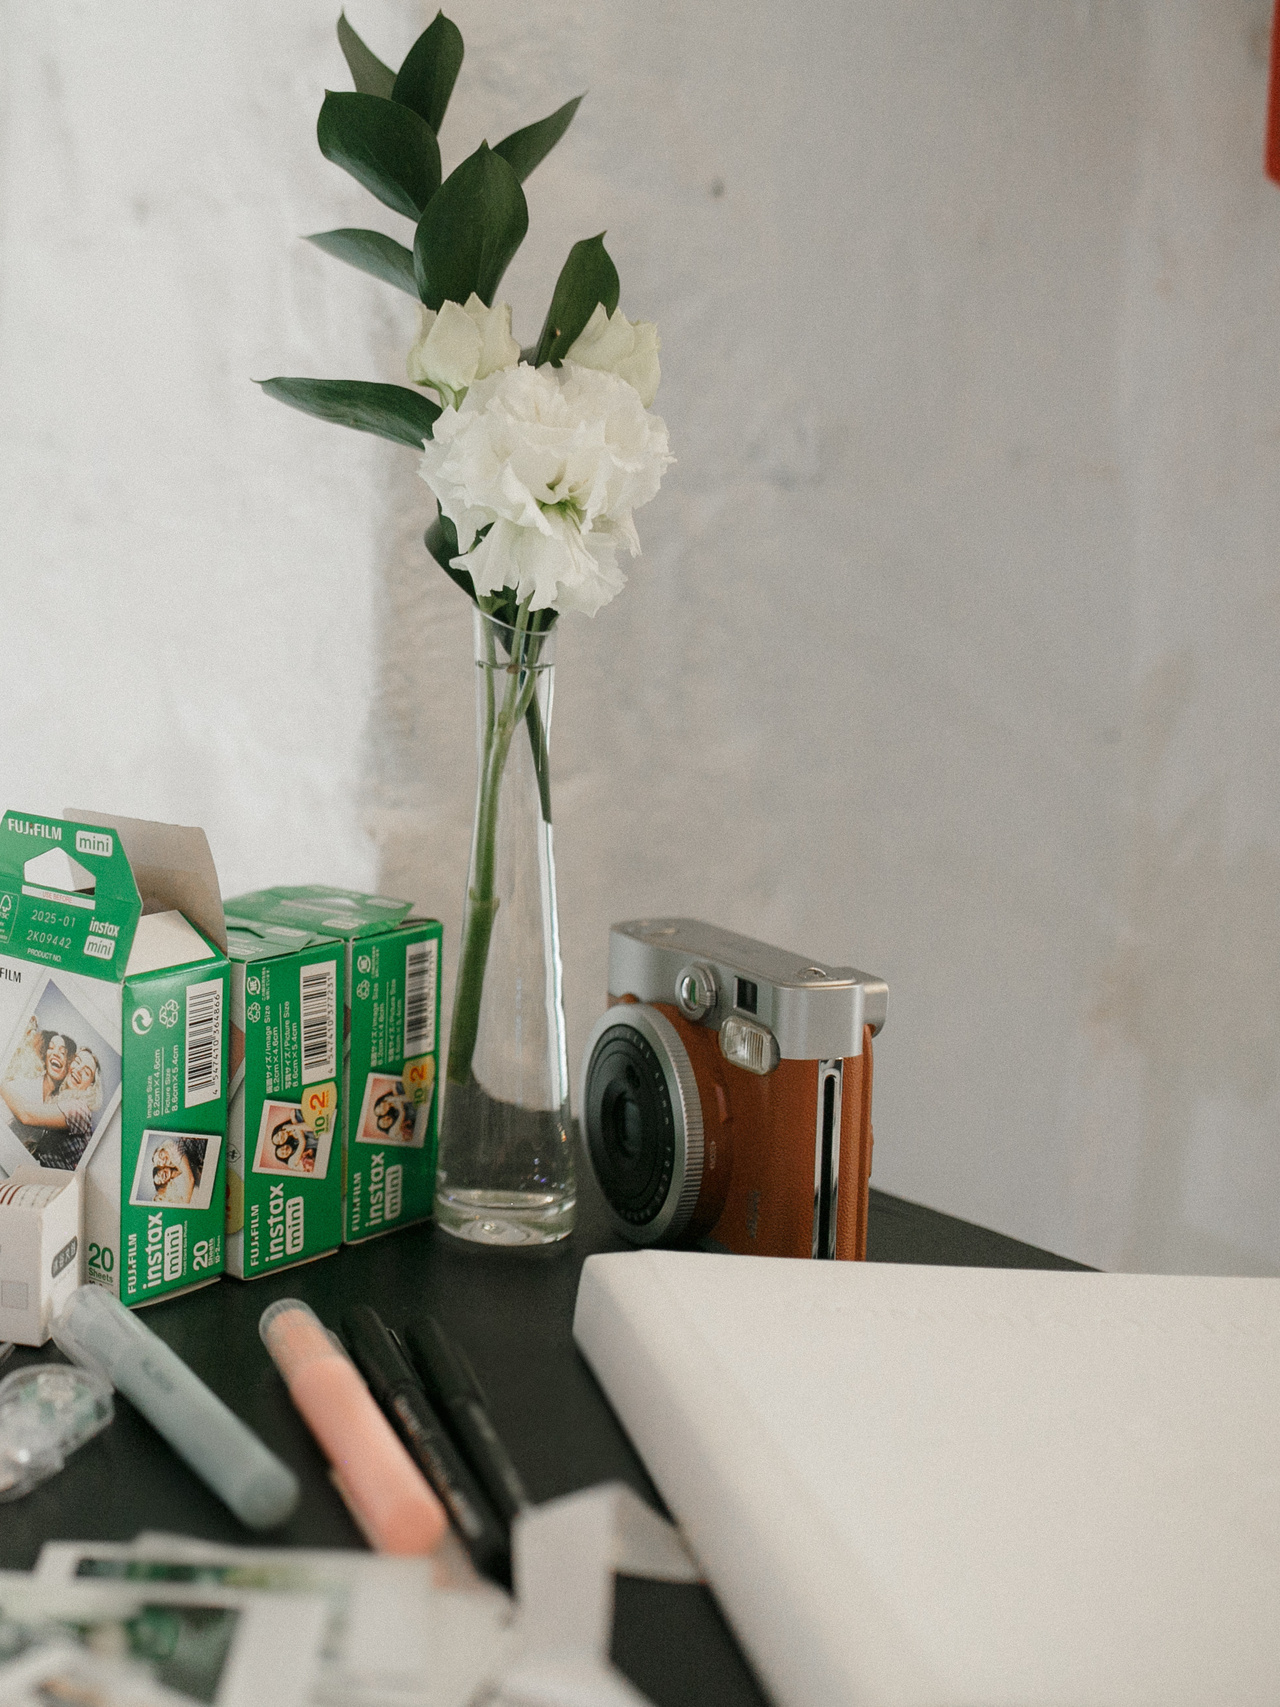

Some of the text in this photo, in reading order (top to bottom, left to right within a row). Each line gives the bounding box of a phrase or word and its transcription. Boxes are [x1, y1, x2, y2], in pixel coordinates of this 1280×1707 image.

[7, 818, 62, 841] FUJIFILM
[79, 834, 110, 853] mini
[31, 909, 76, 928] 2025-01
[89, 917, 120, 938] instax
[26, 929, 72, 949] 2K09442
[27, 948, 52, 960] PRODUCT
[87, 939, 112, 956] mini
[352, 1172, 362, 1232] FUJIFILM
[365, 1152, 384, 1227] instax
[386, 1170, 400, 1214] mini
[250, 1204, 259, 1266] FUJIFILM
[265, 1183, 284, 1262] instax
[288, 1200, 301, 1250] mini
[88, 1242, 114, 1272] 20
[128, 1234, 137, 1294] FUJIFILM
[142, 1212, 162, 1290] instax
[167, 1230, 180, 1275] mini
[192, 1240, 208, 1271] 20
[88, 1268, 113, 1283] Sheets
